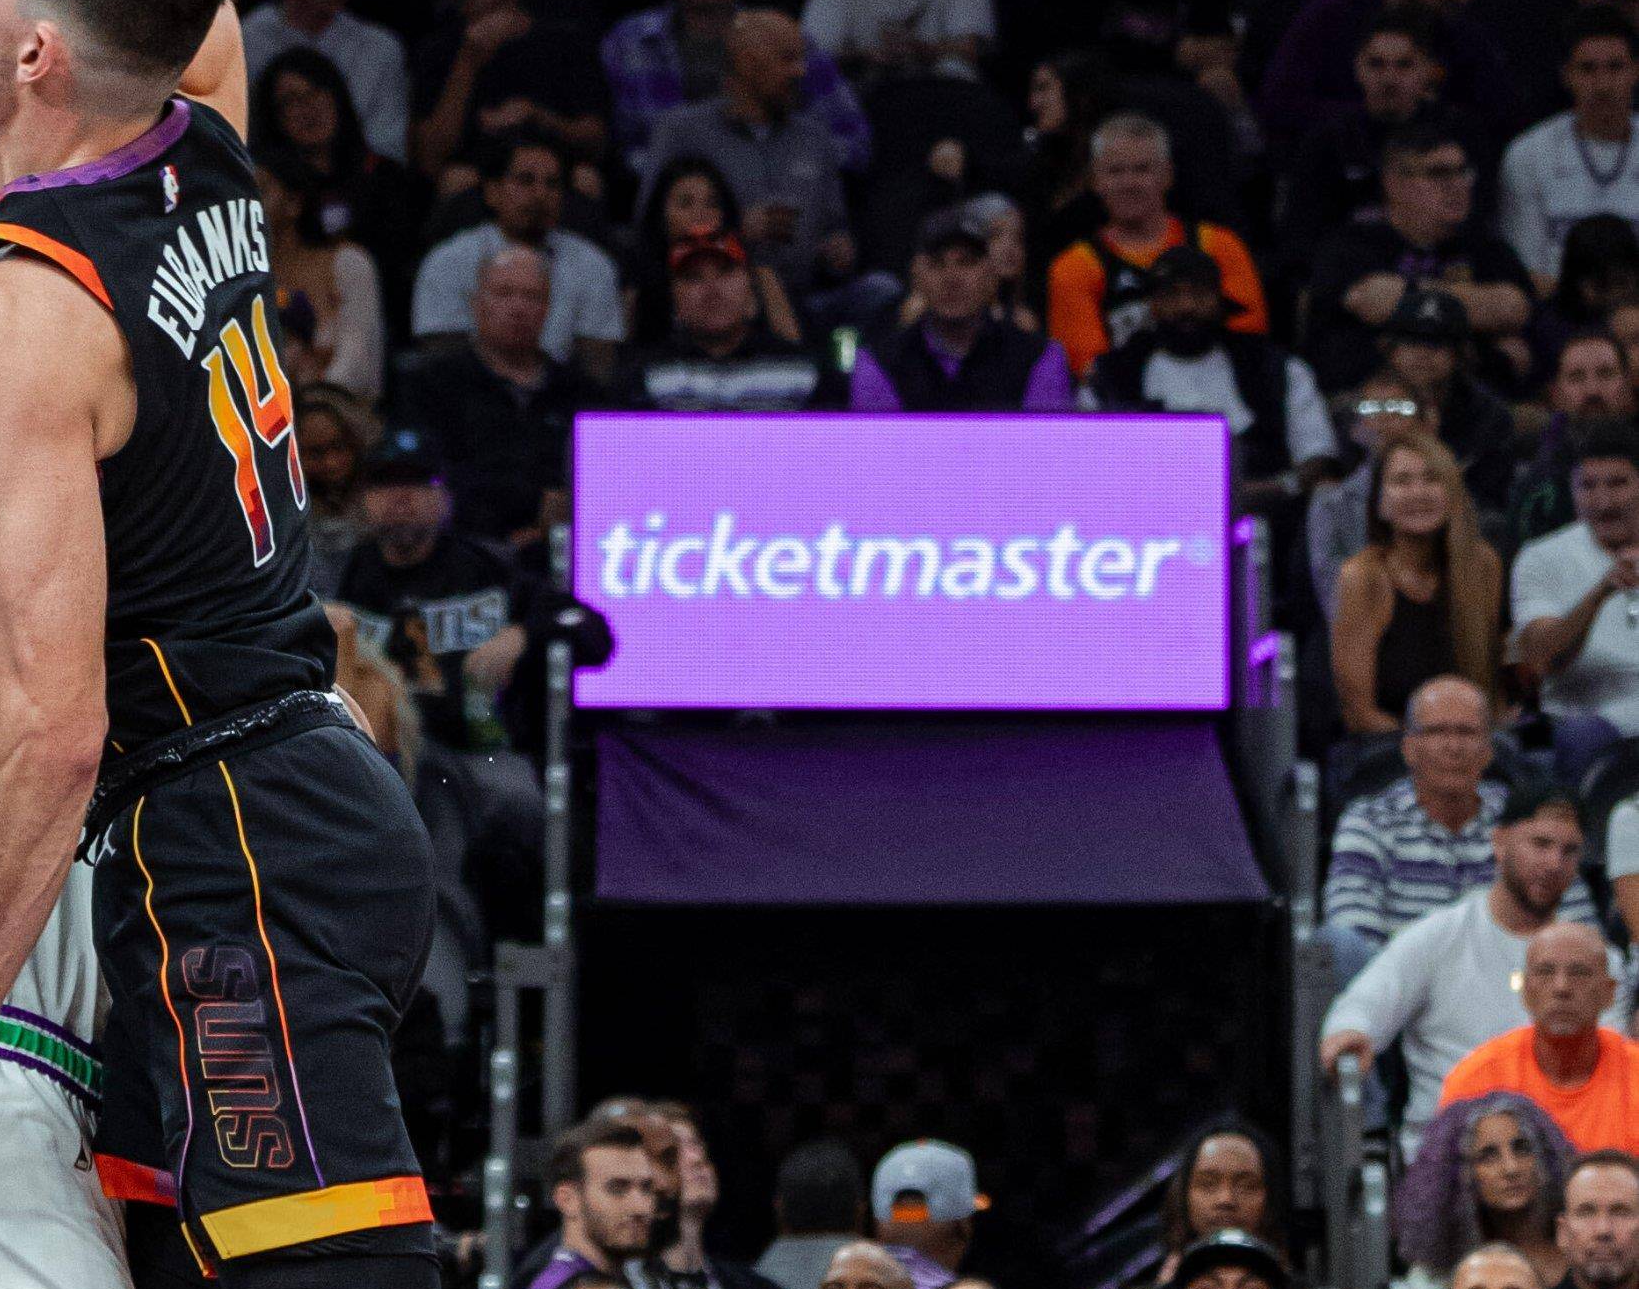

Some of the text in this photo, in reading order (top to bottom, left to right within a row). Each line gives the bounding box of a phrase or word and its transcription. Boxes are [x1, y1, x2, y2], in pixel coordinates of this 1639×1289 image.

[147, 198, 269, 361] EUBANKS
[201, 294, 306, 568] 14
[597, 512, 1180, 600] ticketmaster
[181, 946, 296, 1169] SUNS
